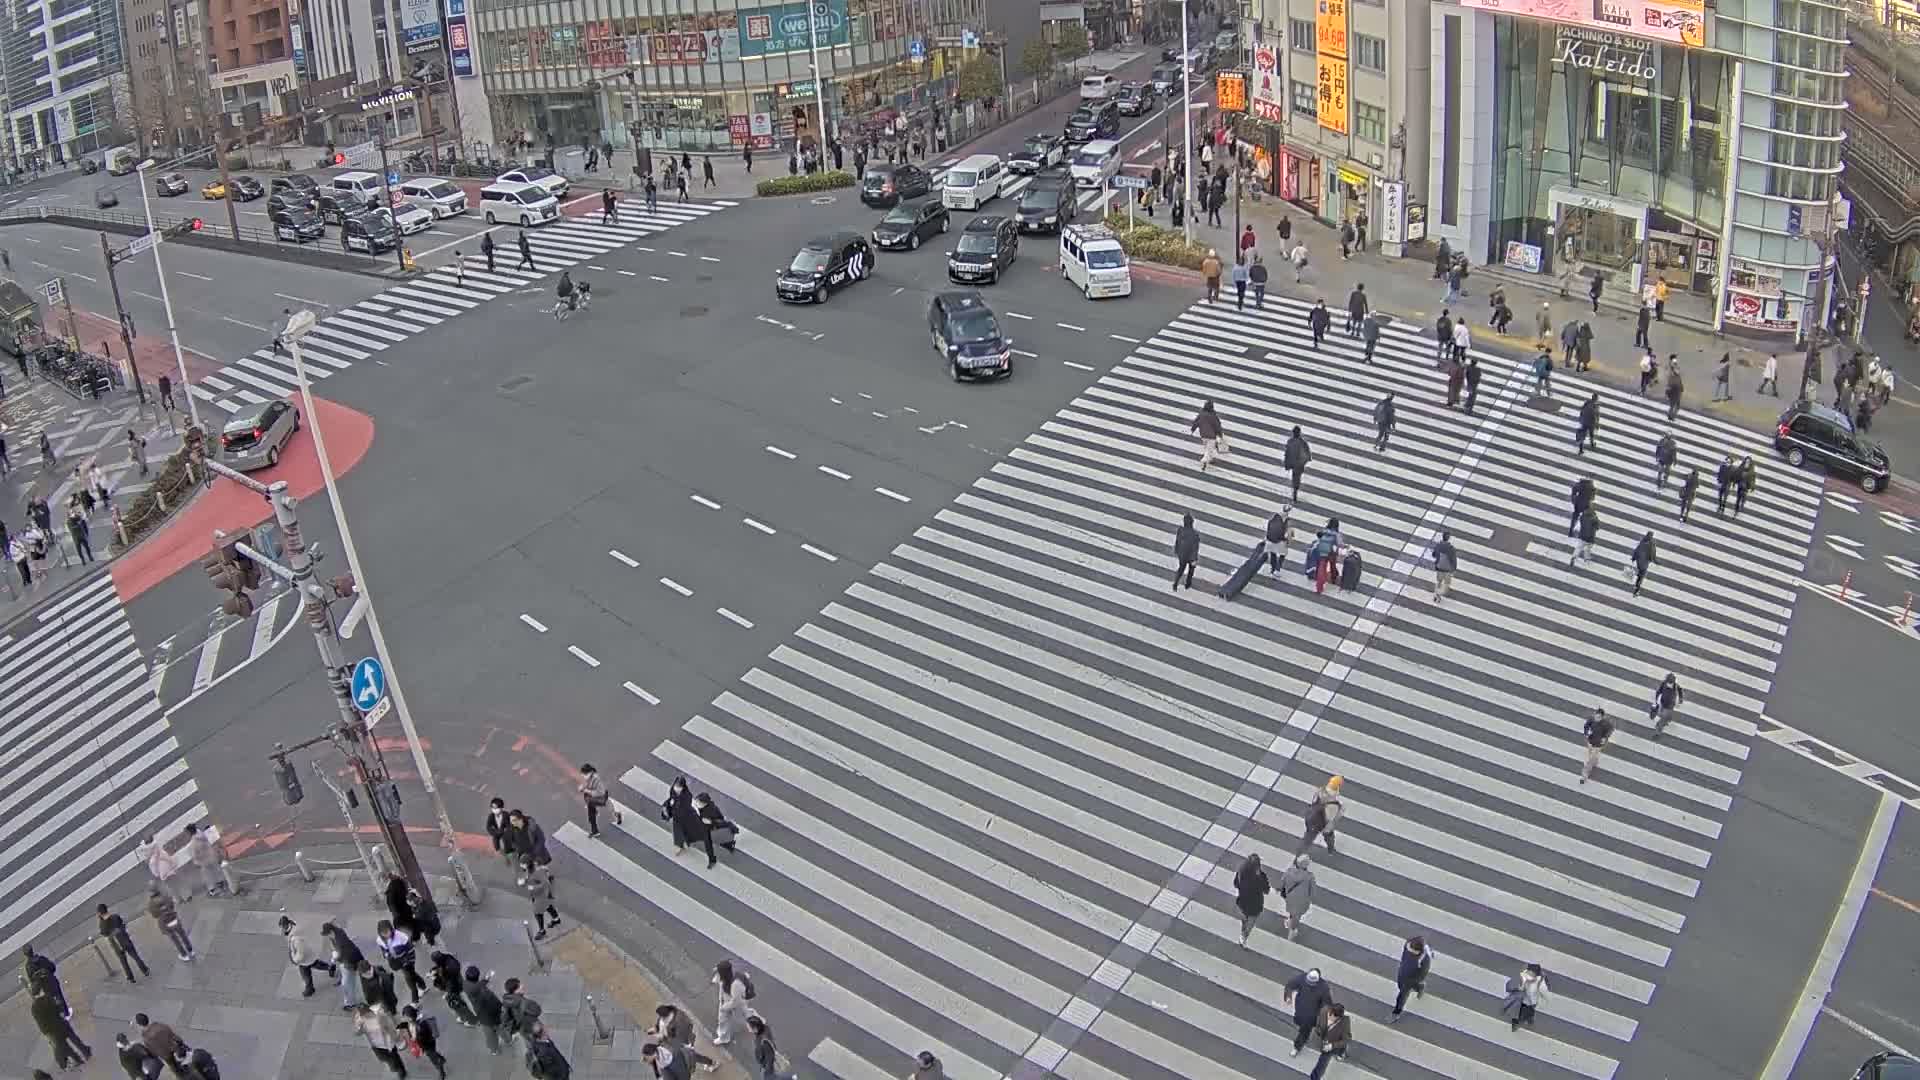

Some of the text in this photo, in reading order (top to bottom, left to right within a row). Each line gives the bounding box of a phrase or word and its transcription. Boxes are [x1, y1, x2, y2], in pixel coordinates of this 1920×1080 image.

[1556, 25, 1651, 50] PACHINKO & SLOT
[1551, 37, 1657, 79] Kaleido
